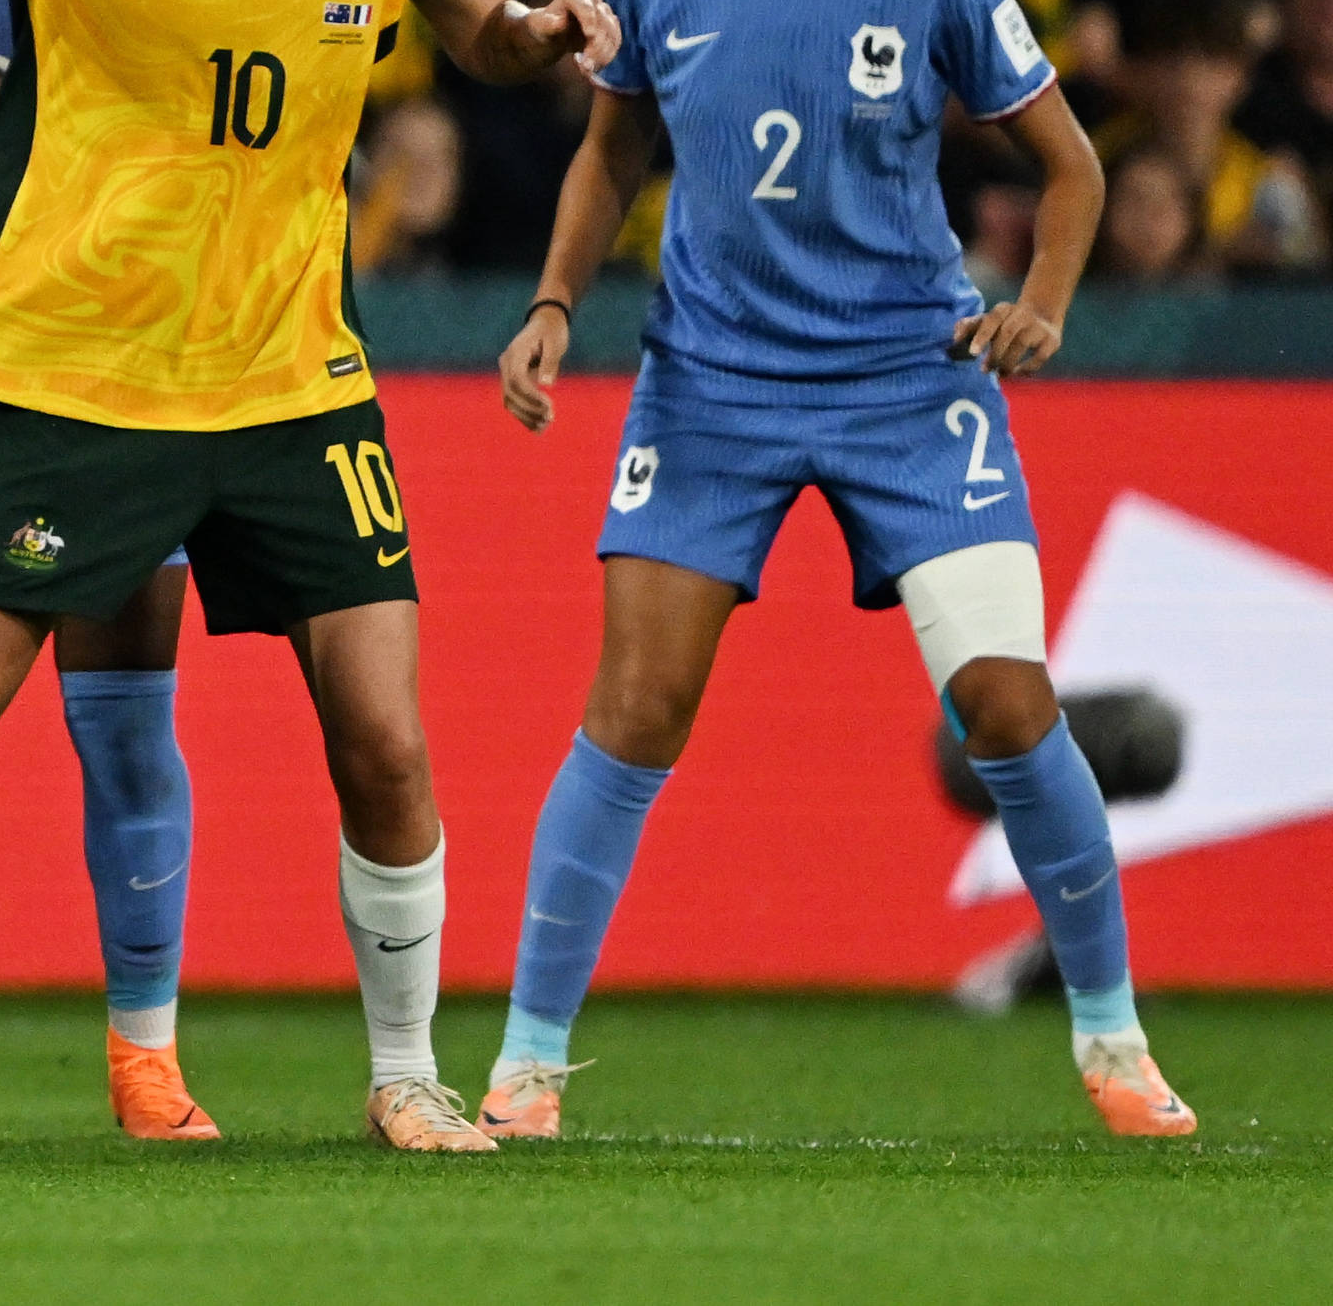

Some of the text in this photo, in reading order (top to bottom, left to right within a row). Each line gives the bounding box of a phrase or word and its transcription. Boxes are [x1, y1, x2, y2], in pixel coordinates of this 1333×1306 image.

[207, 48, 286, 150] 10
[751, 108, 802, 200] 2
[945, 398, 1005, 483] 2
[325, 440, 404, 538] 10
